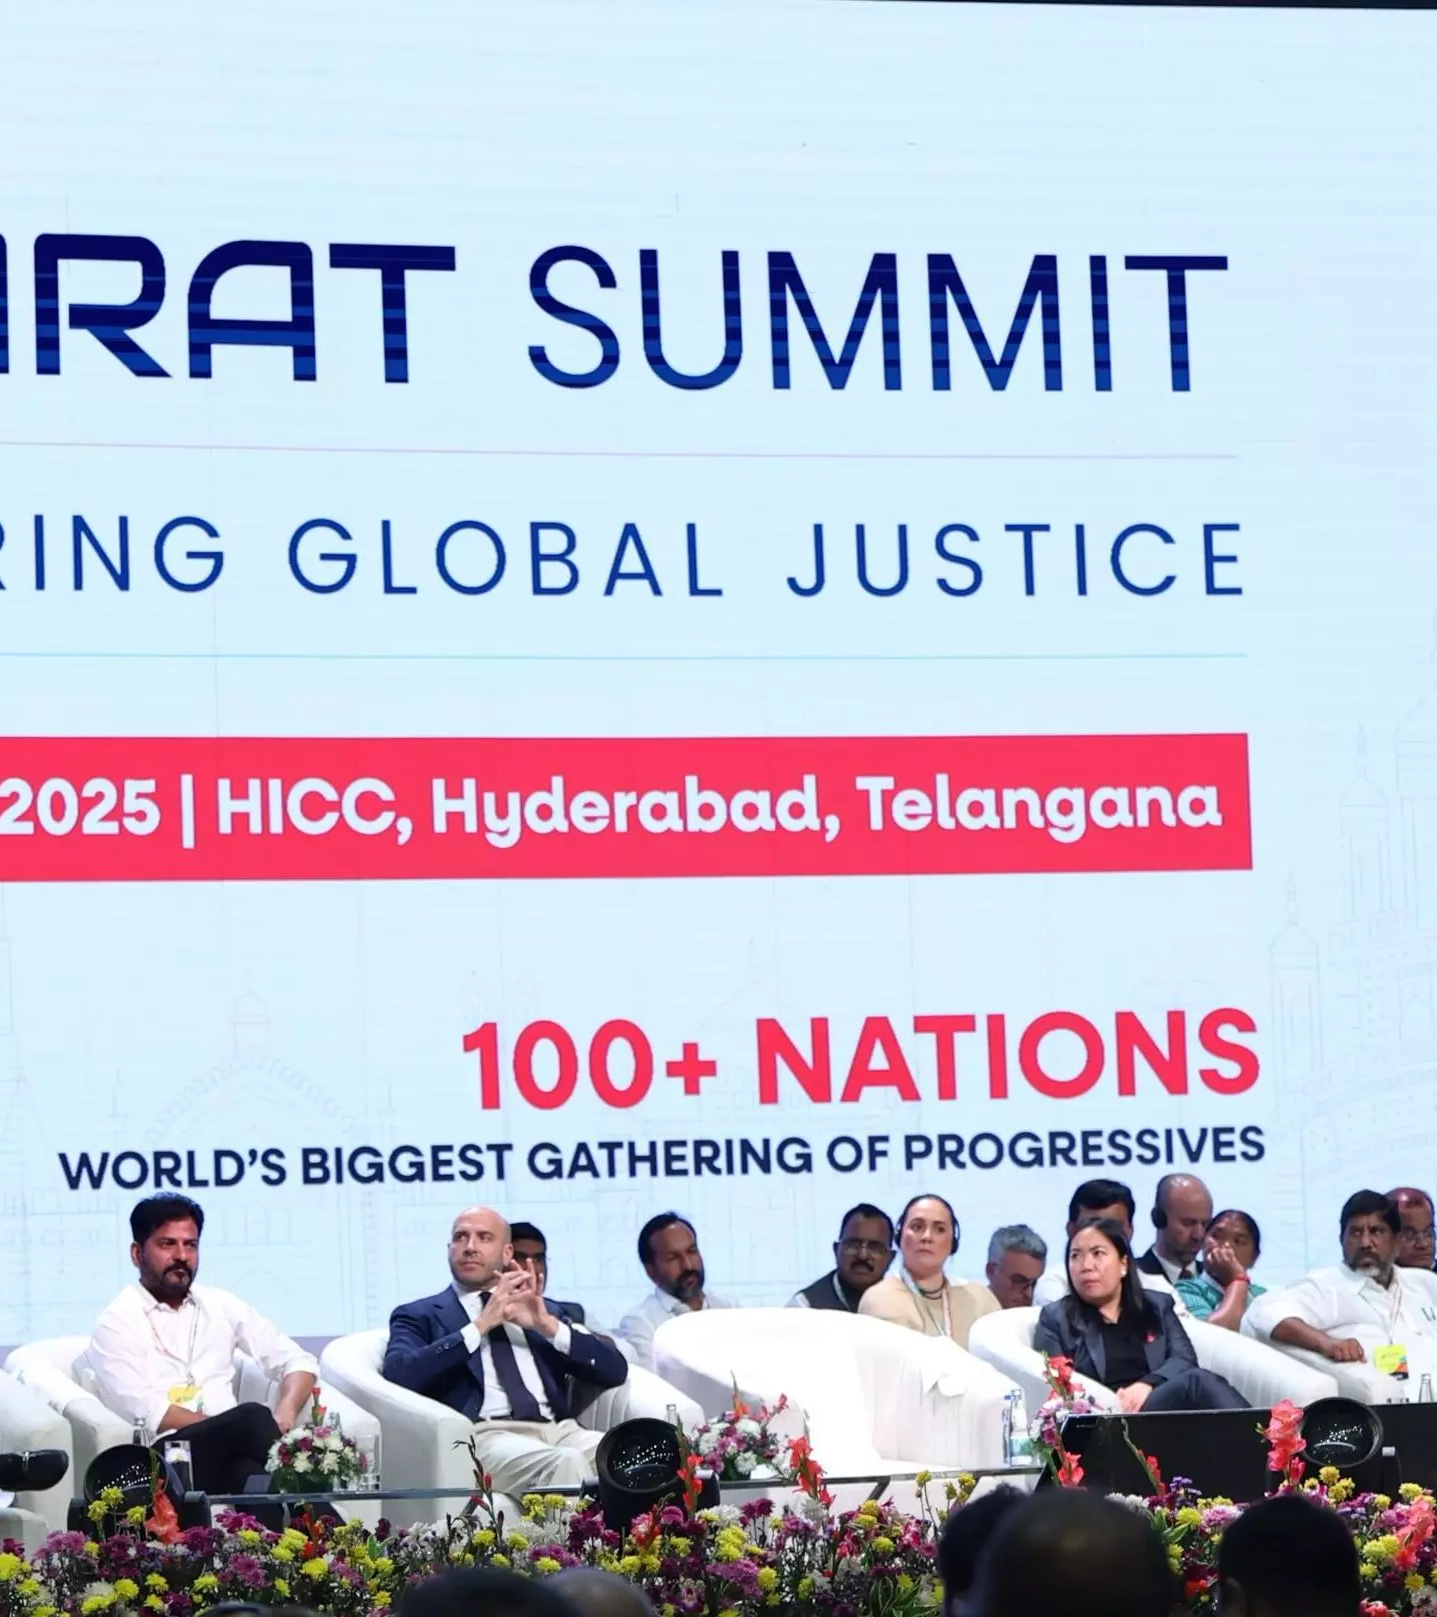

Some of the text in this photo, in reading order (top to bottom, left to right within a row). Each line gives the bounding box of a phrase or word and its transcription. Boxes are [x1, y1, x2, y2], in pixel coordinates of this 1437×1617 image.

[528, 245, 1228, 392] SUMMIT
[288, 518, 723, 596] GLOBAL
[787, 523, 1242, 597] JUSTICE
[217, 777, 413, 846] HICC,
[432, 774, 840, 849] Hyderabad,
[855, 773, 1223, 843] Telangana
[463, 1007, 1261, 1110] 100+ NATIONS
[301, 1143, 514, 1185] BIGGEST
[527, 1136, 813, 1180] GATHERING
[826, 1135, 890, 1173] OF
[904, 1125, 1265, 1171] PROGRESSIVES
